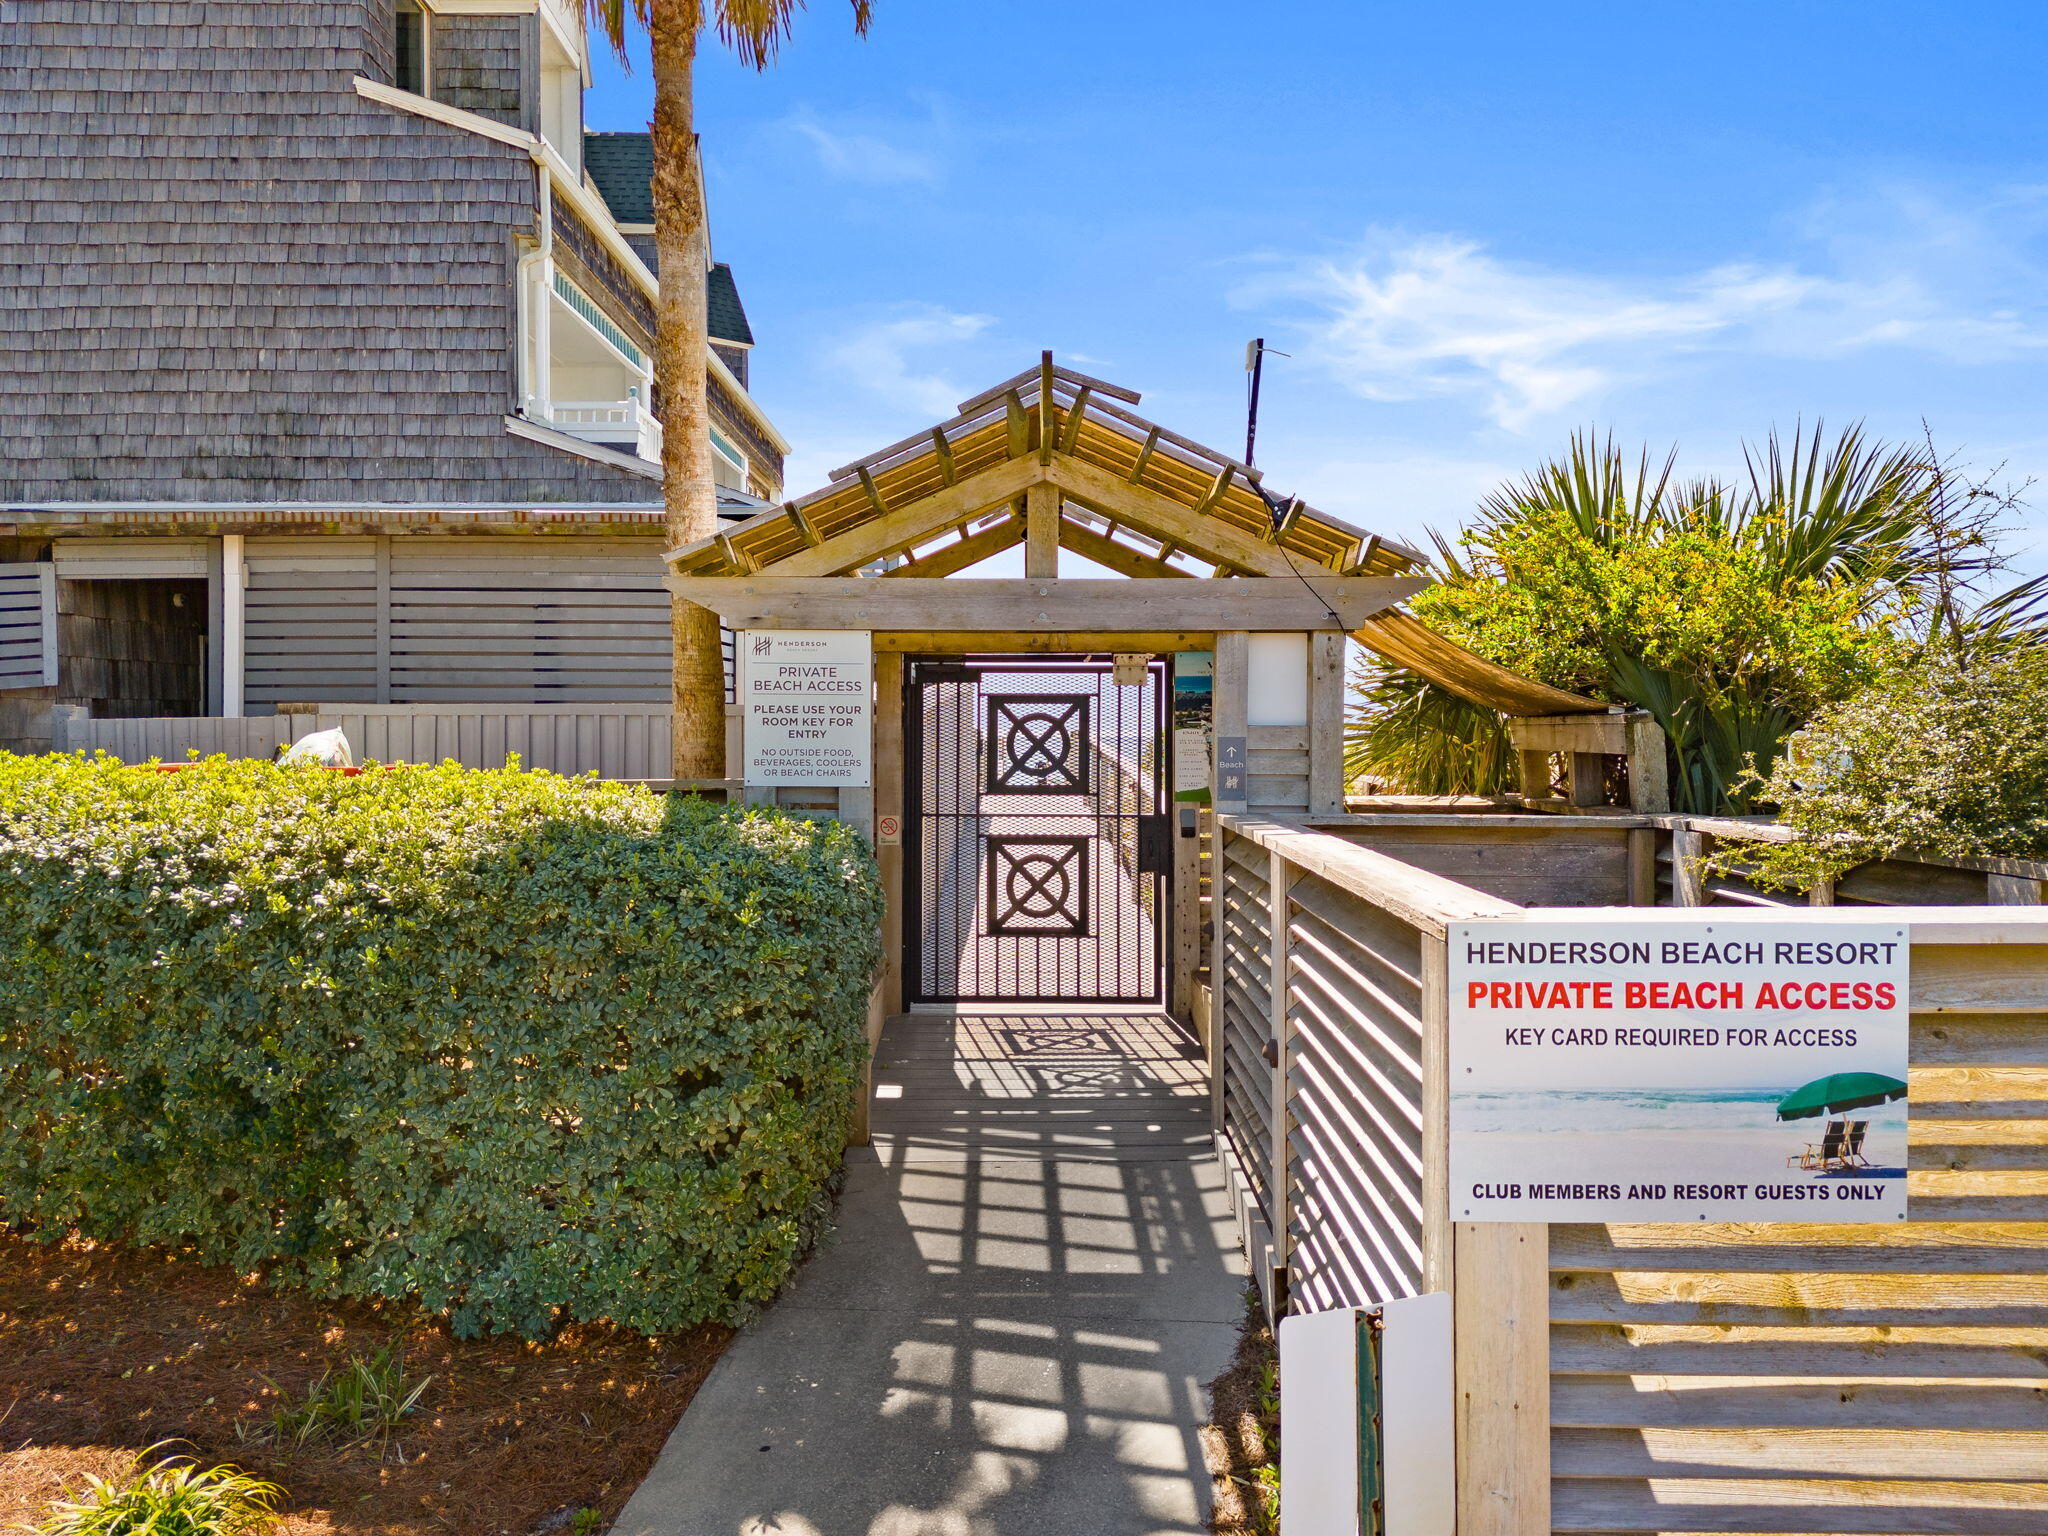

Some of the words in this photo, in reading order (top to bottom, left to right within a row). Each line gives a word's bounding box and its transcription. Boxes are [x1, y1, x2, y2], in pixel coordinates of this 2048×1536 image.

[779, 667, 837, 677] PRIVATE
[754, 681, 801, 690] BEACH
[807, 681, 862, 691] ACCESS
[803, 706, 825, 714] USE
[829, 706, 861, 714] YOUR
[763, 718, 798, 726] ROOM
[802, 718, 824, 726] KEY
[830, 718, 853, 726] FOR
[789, 730, 827, 738] ENTRY
[754, 759, 813, 767] BEVERAGES,
[1467, 942, 1651, 964] HENDERSON
[1661, 942, 1763, 964] BEACH
[1774, 942, 1898, 965] RESORT
[1468, 982, 1613, 1009] PRIVATE
[1625, 982, 1743, 1009] BEACH
[1755, 982, 1896, 1010] ACCESS
[1505, 1029, 1545, 1046] KEY
[1551, 1029, 1609, 1046] CARD
[1615, 1029, 1719, 1048] REQUIRED
[1726, 1029, 1767, 1046] FOR
[1773, 1029, 1857, 1047] ACCESS
[1472, 1184, 1521, 1200] CLUB
[1528, 1184, 1621, 1200] MEMBERS
[1628, 1184, 1666, 1200] AND
[1673, 1184, 1748, 1200] RESORT
[1755, 1184, 1830, 1200] GUESTS
[1836, 1184, 1885, 1200] ONLY
